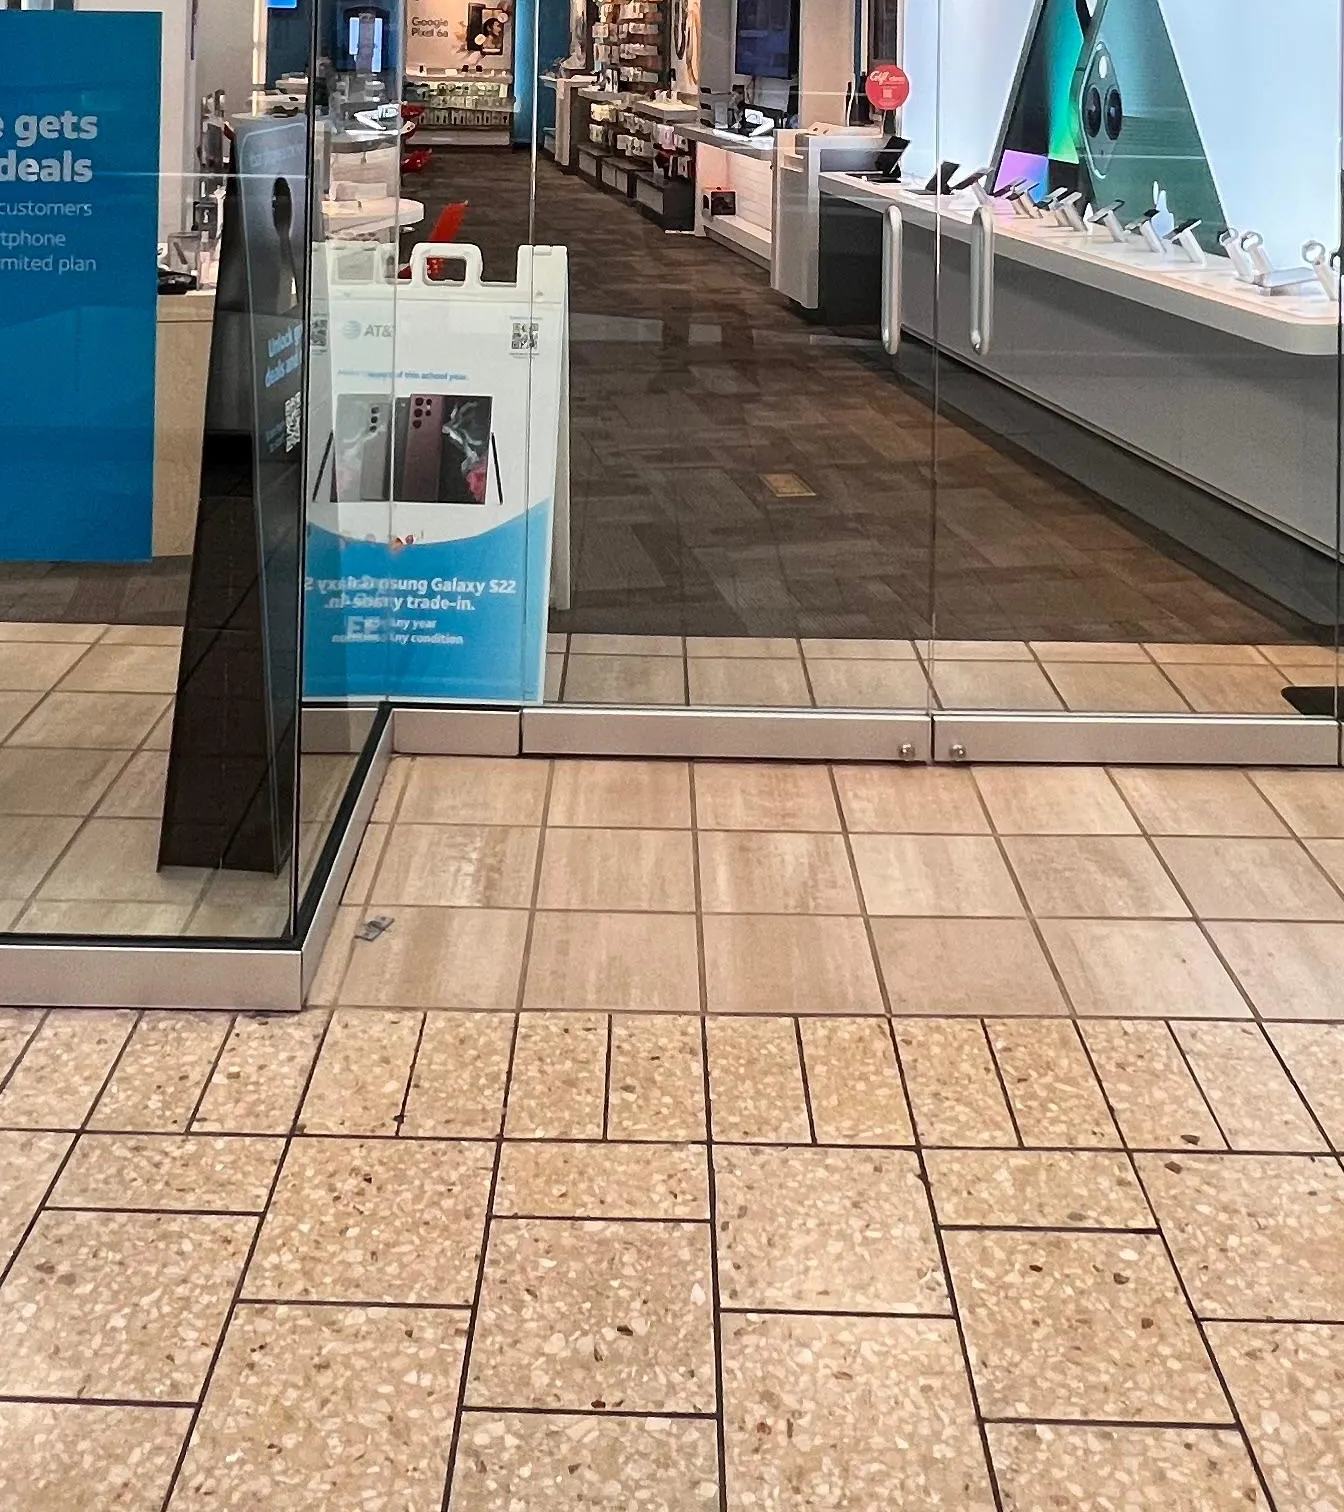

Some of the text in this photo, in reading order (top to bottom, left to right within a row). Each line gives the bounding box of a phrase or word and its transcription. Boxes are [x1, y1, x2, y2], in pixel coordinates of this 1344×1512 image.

[412, 17, 449, 29] Google
[14, 110, 98, 148] gets
[58, 257, 96, 275] plan
[364, 324, 396, 338] AT&
[431, 577, 485, 596] Galaxy
[488, 579, 517, 594] S22
[407, 594, 477, 611] trade-in.
[412, 619, 437, 631] year
[411, 633, 465, 645] condition
